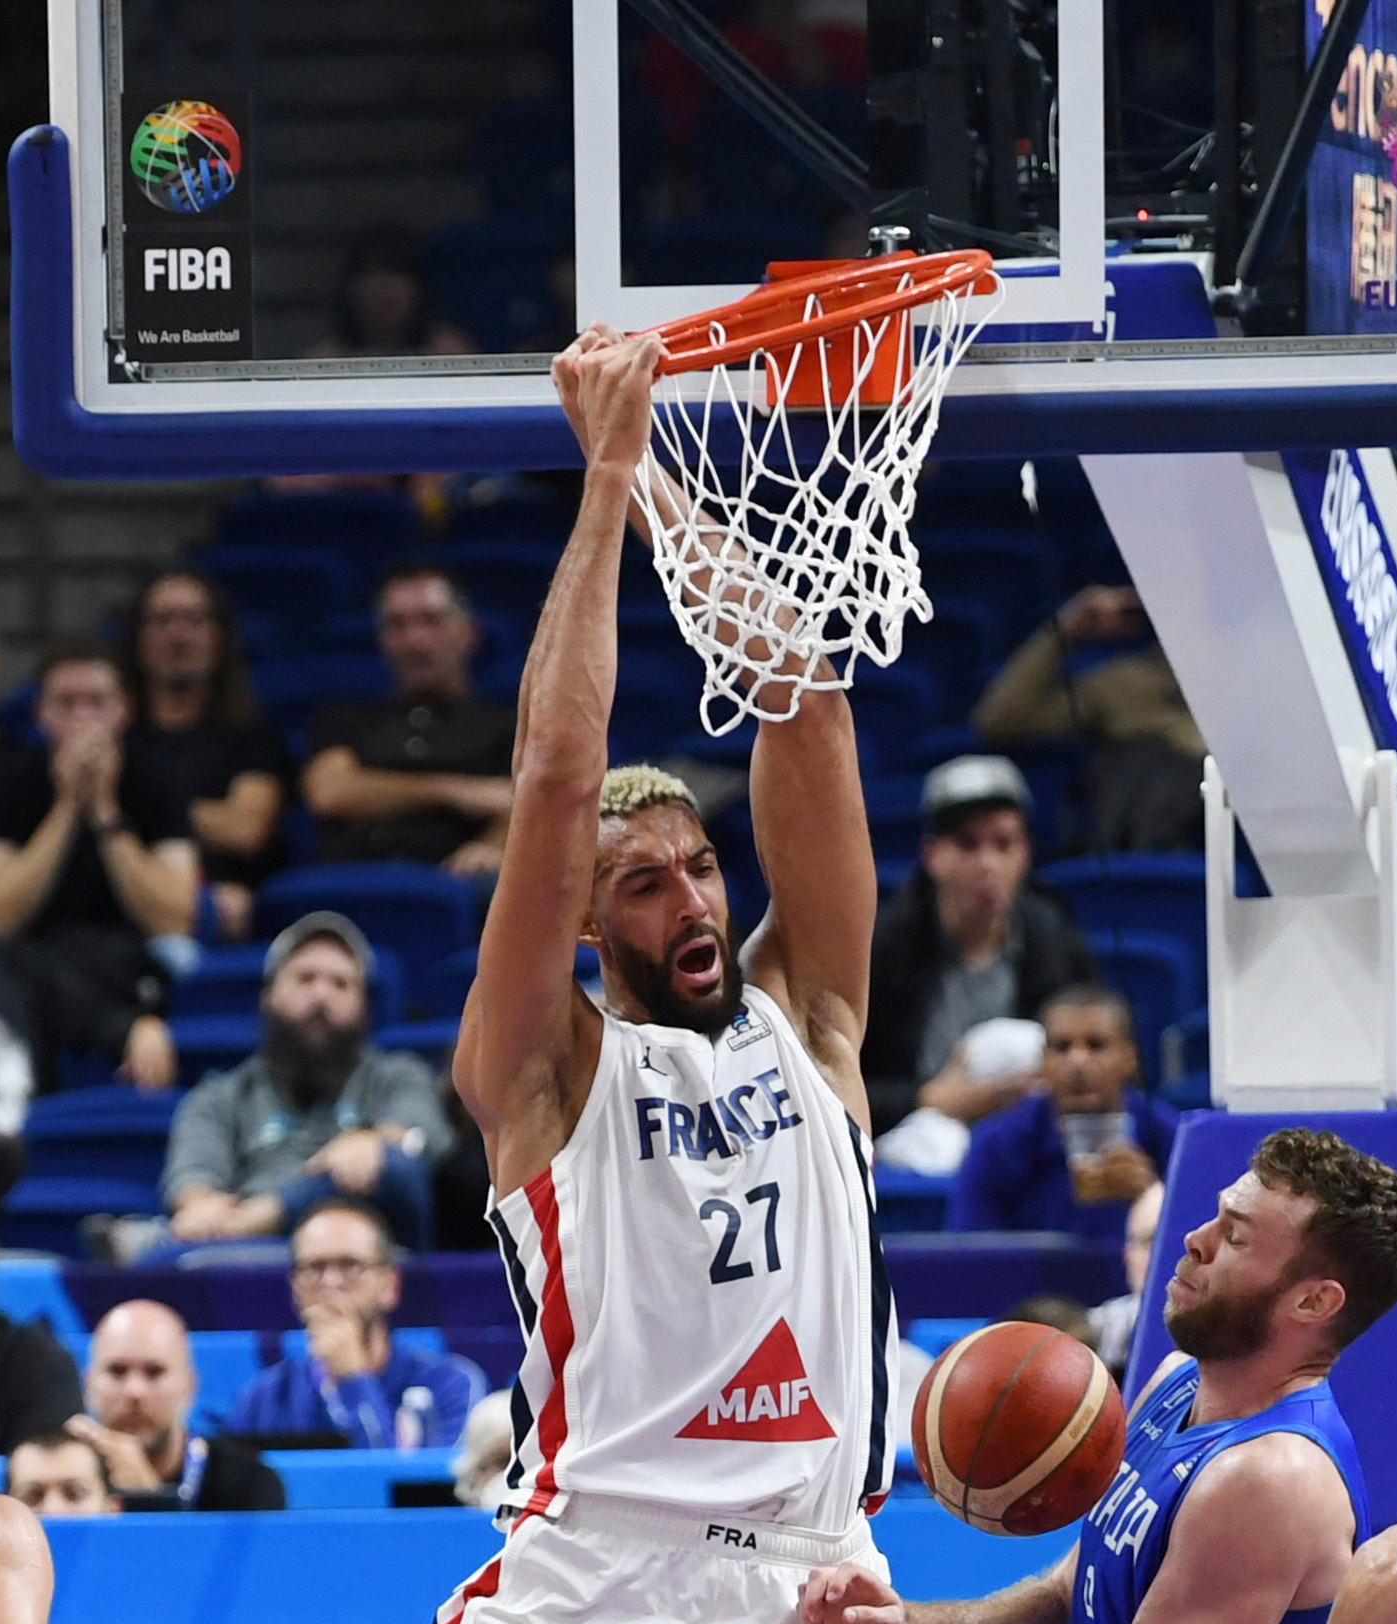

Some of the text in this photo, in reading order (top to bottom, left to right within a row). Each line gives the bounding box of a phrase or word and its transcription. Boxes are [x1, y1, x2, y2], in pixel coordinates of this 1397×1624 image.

[144, 246, 232, 292] FIBA
[138, 329, 240, 344] We Are Basketball
[700, 1182, 782, 1285] 27
[707, 1377, 810, 1426] MAIF
[706, 1524, 758, 1550] FRA
